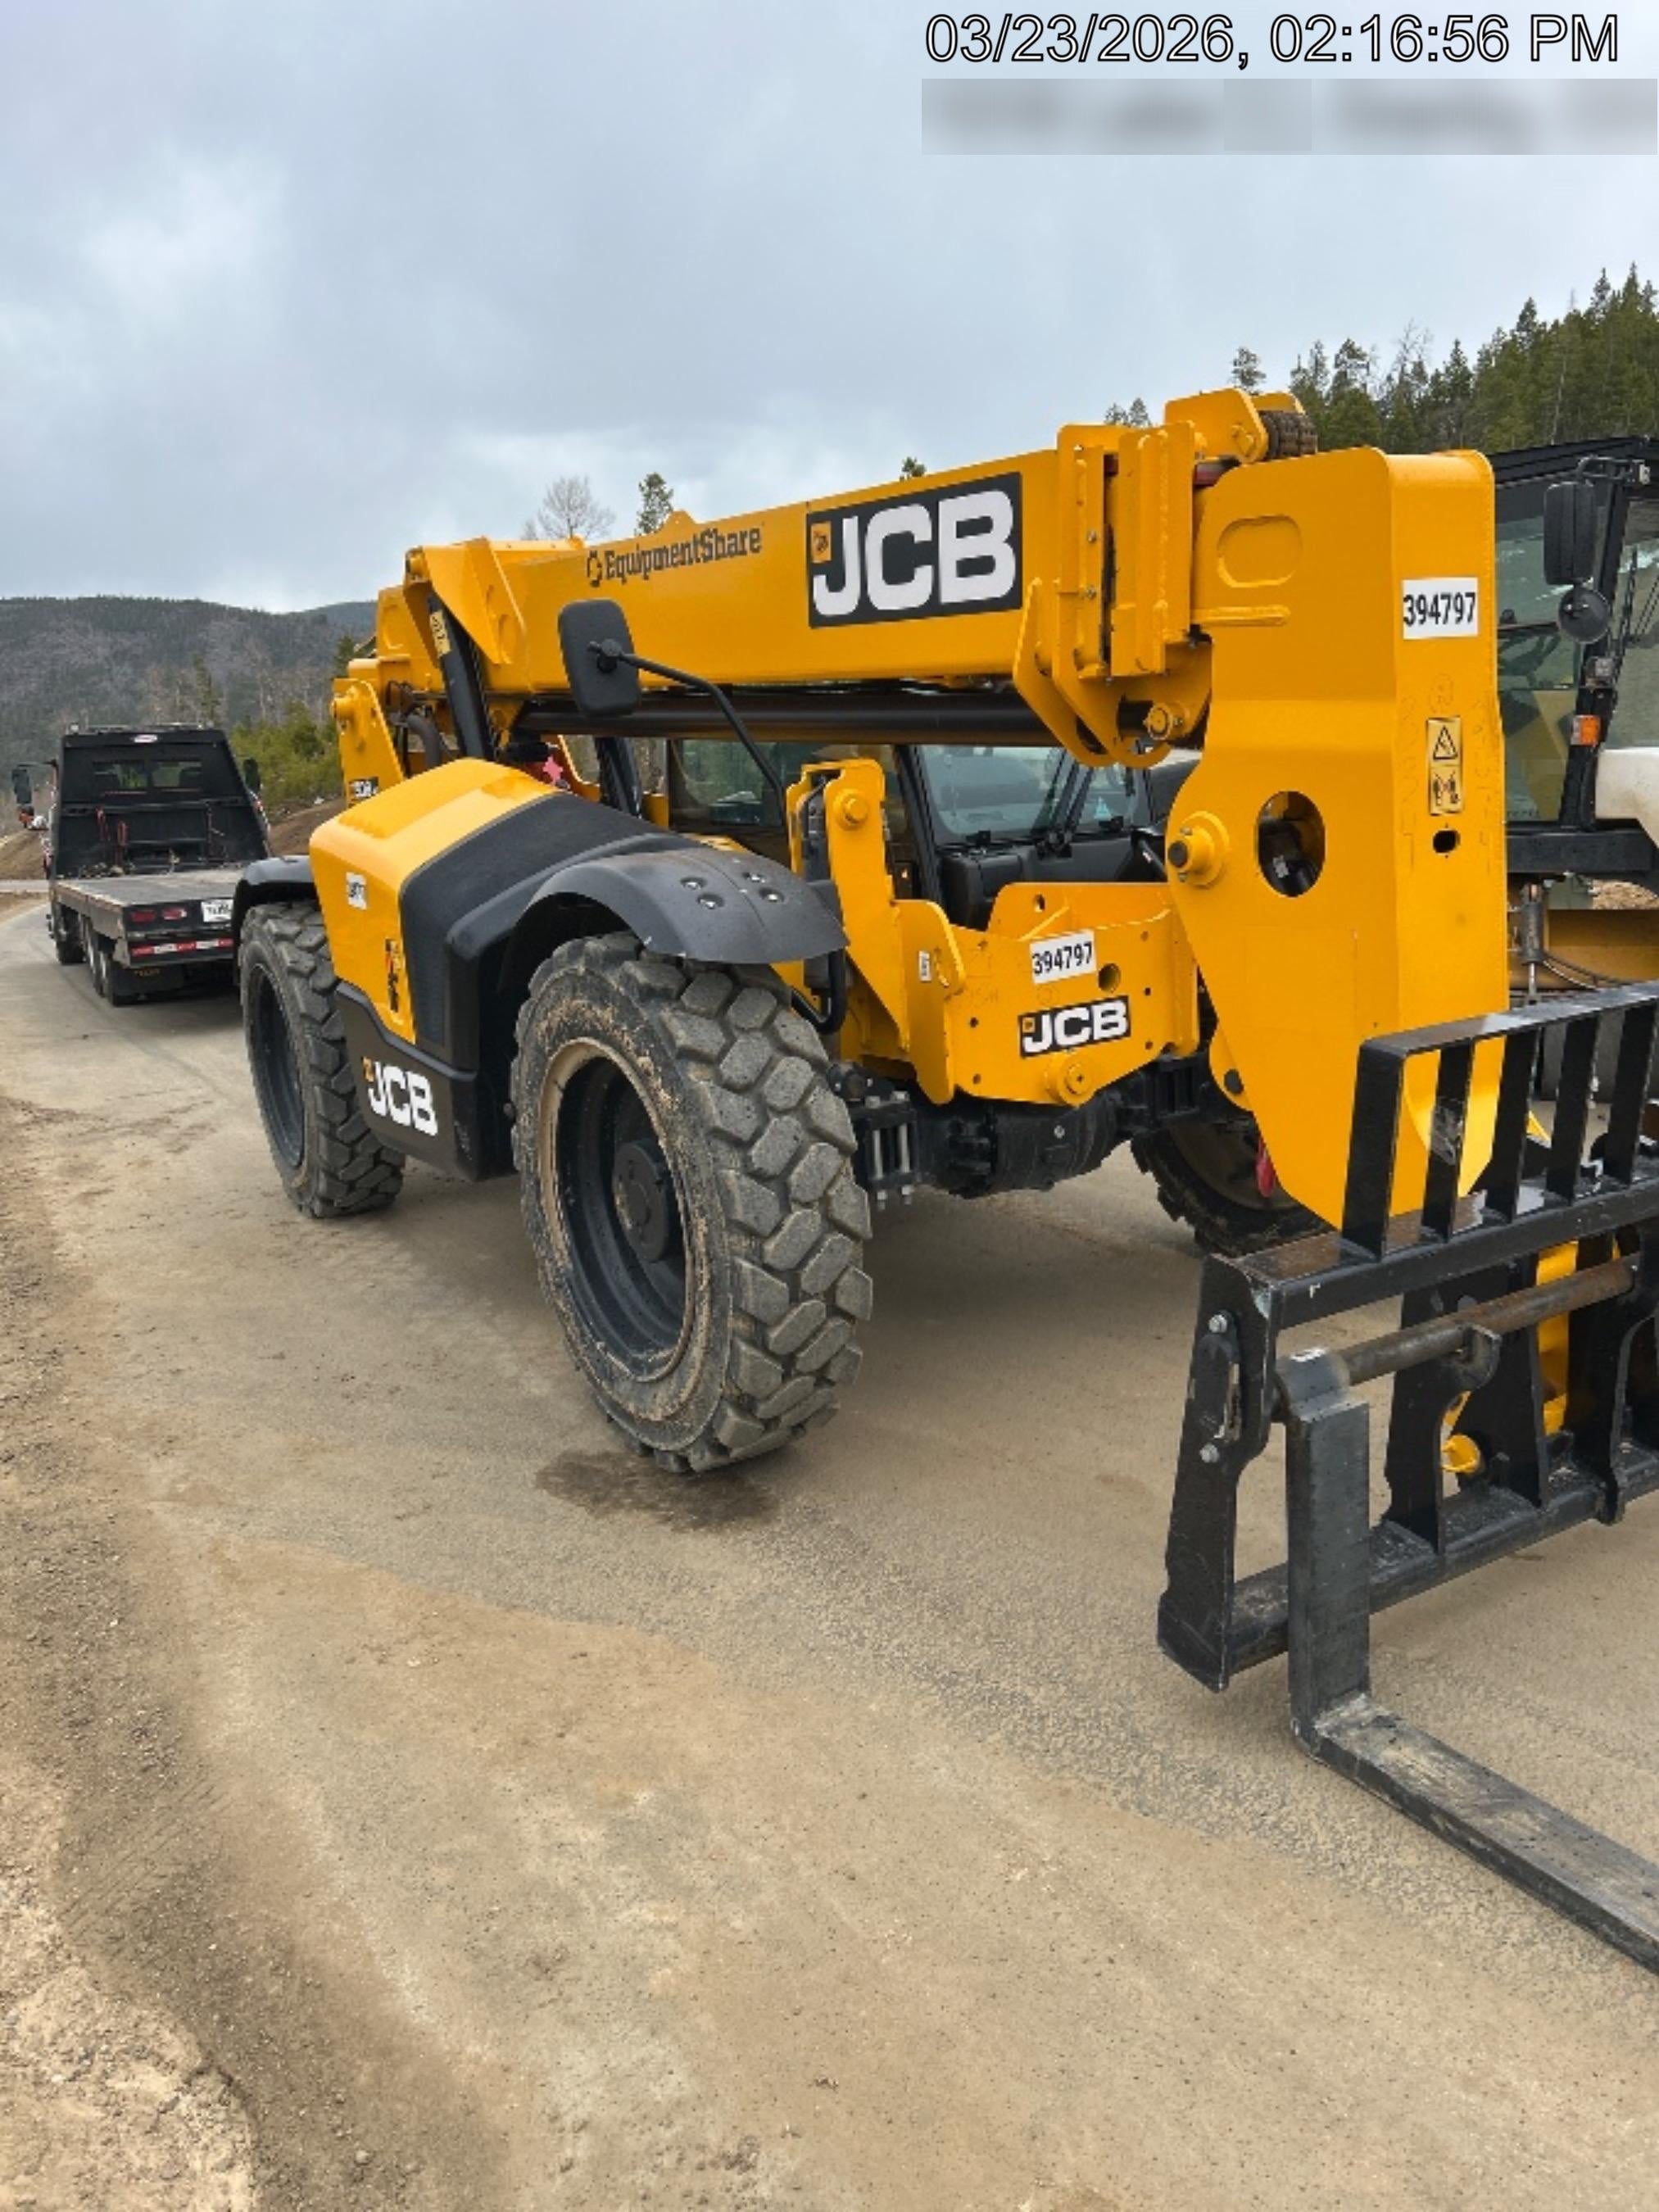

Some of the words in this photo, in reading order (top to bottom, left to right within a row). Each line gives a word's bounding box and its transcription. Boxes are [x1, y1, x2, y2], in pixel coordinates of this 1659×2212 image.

[605, 528, 762, 586] EquipmentShare
[813, 490, 1017, 616] JCB
[1403, 592, 1476, 627] 394797
[1032, 941, 1093, 975] 394797
[1023, 1000, 1129, 1053] JCB
[368, 1060, 438, 1136] JCB
